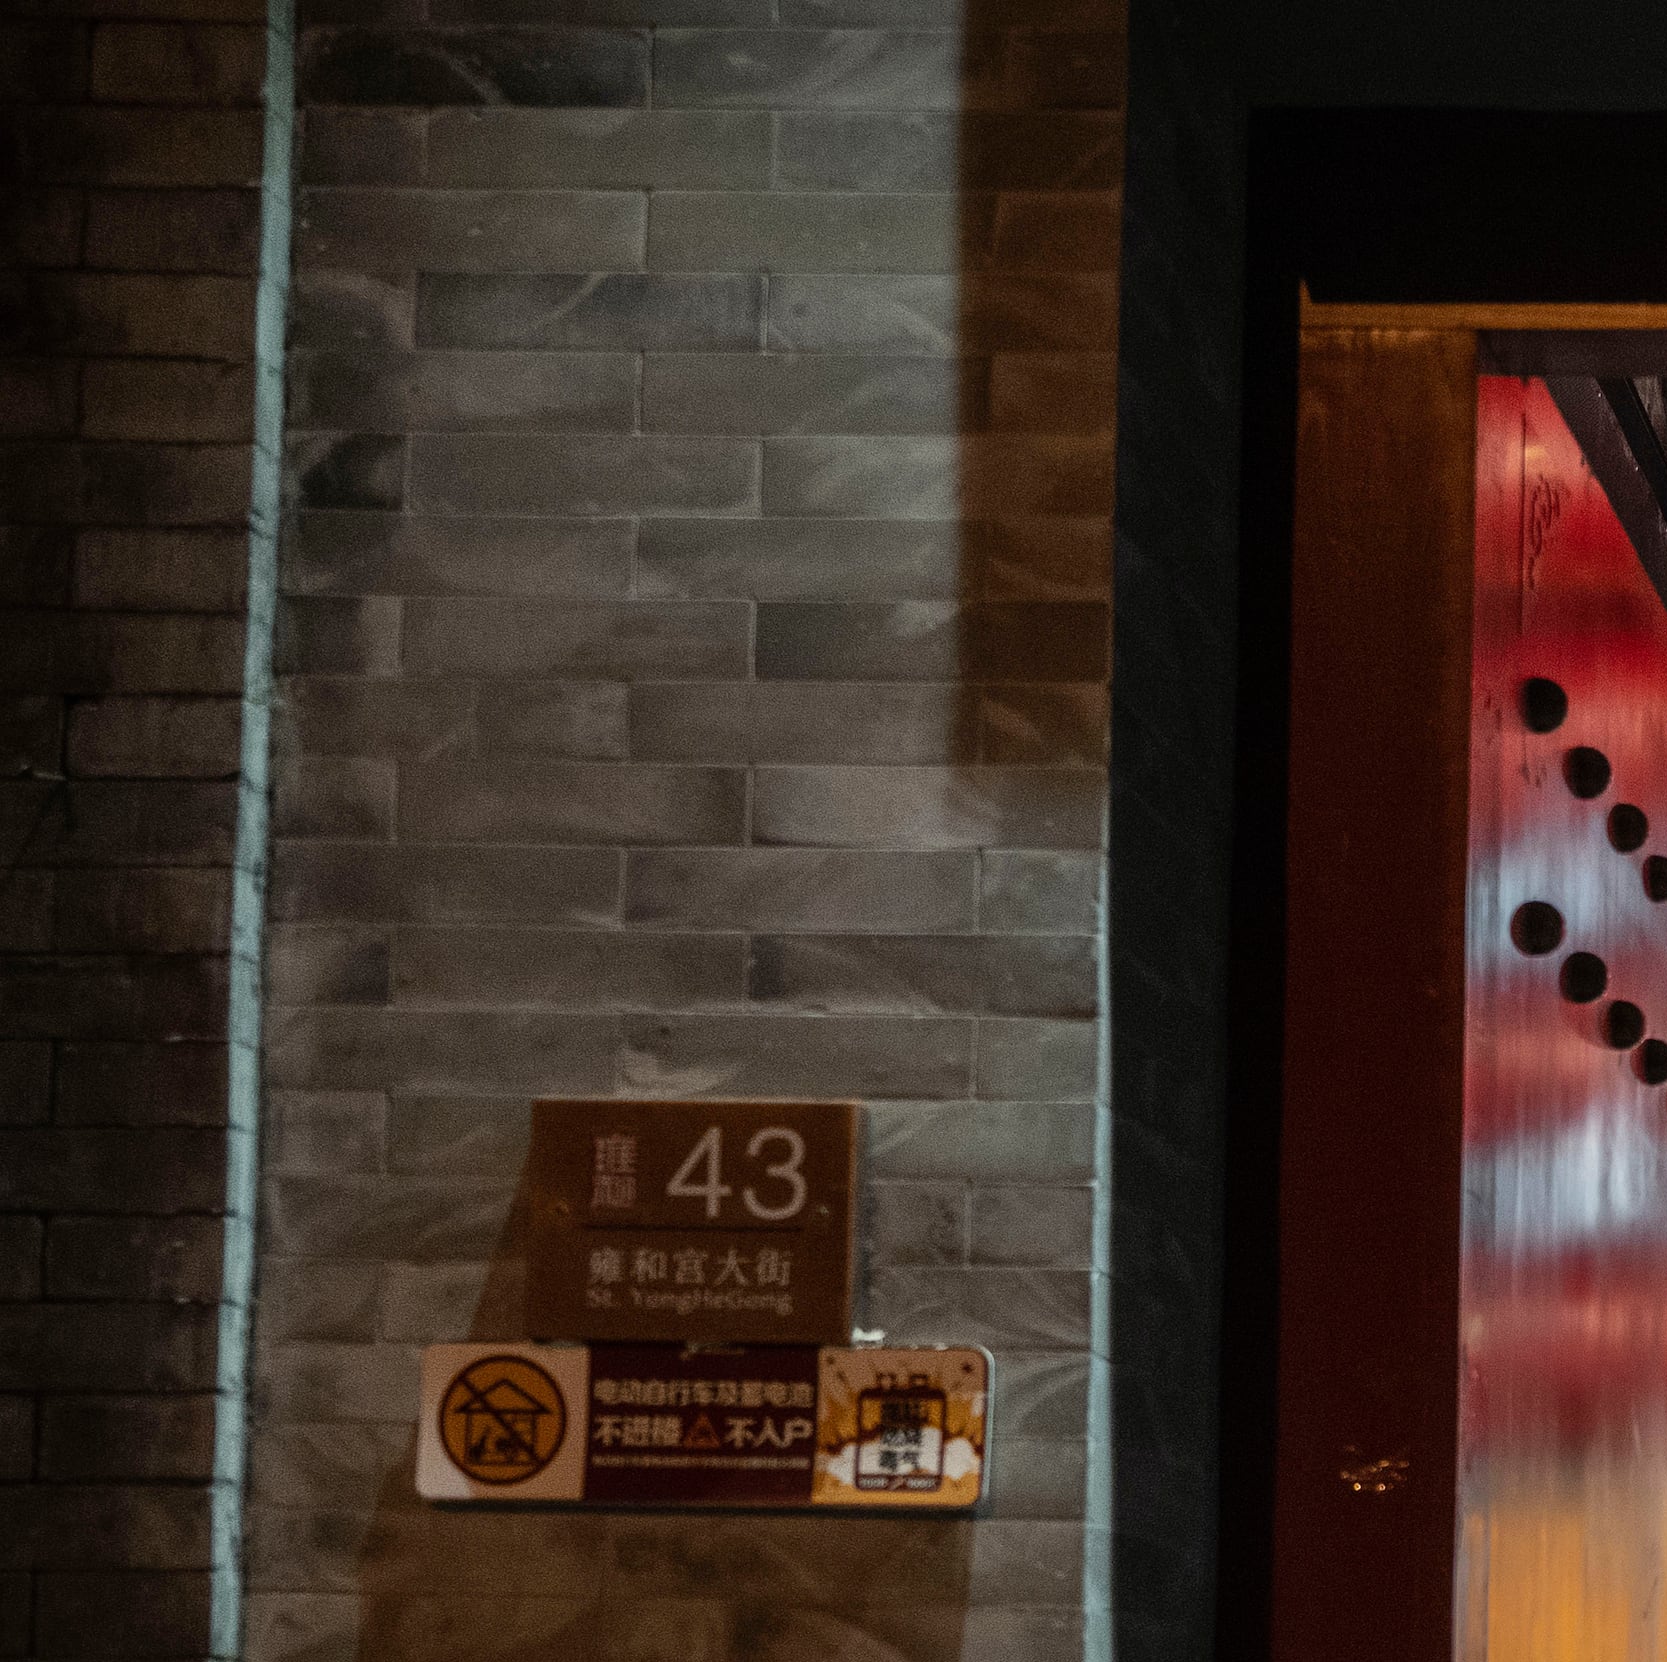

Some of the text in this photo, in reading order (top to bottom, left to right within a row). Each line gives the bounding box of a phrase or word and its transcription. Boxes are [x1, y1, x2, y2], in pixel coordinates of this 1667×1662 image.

[667, 1126, 808, 1220] 43
[590, 1246, 794, 1287] 雍和宫大街
